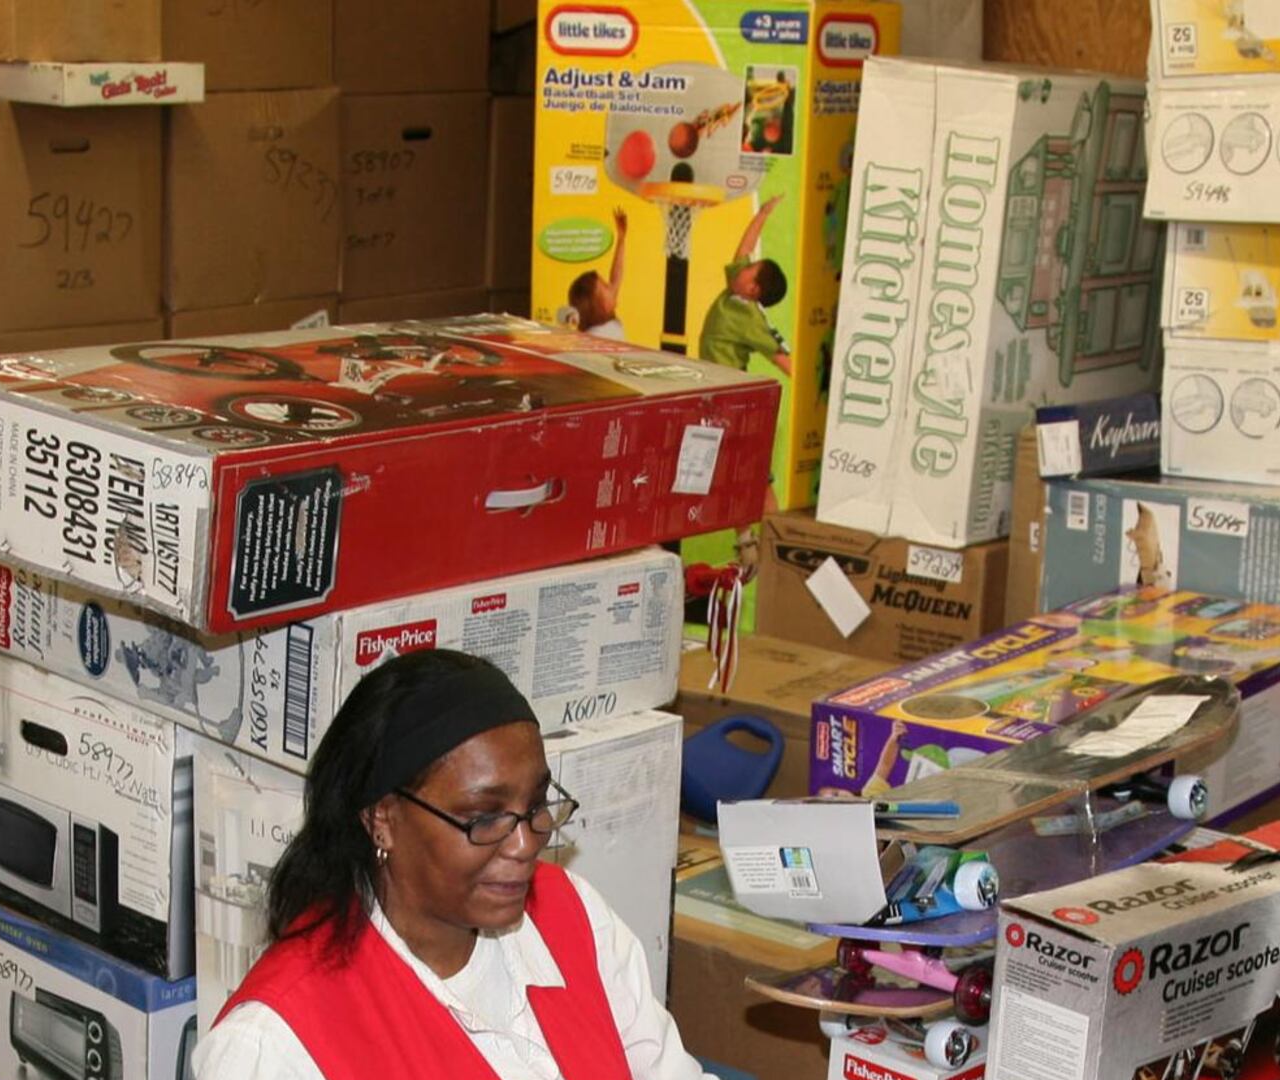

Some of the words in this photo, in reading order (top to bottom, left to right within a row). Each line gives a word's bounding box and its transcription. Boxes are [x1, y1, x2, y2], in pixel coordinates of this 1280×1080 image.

[557, 20, 589, 39] little
[591, 22, 627, 40] tikes
[543, 88, 615, 102] Basketball
[618, 90, 641, 102] Set
[544, 68, 614, 88] Adjust
[618, 71, 634, 88] &
[638, 71, 687, 91] Jam
[543, 100, 586, 113] Juego
[589, 100, 606, 112] de
[609, 101, 685, 116] baloncesto
[838, 161, 923, 430] Kitchen
[912, 131, 1001, 480] Homesyle
[1090, 412, 1160, 460] Keyboar
[24, 428, 60, 519] 35112
[62, 440, 102, 565] 6308431
[870, 583, 973, 621] McQUEEN
[358, 628, 436, 656] Fisher-Price
[73, 704, 164, 746] professional
[562, 691, 618, 724] K6070
[829, 714, 845, 778] SMART
[841, 716, 858, 780] CYCLE
[1086, 877, 1199, 915] Razor
[1025, 931, 1097, 970] Razor
[1037, 954, 1067, 975] Cruiser
[1067, 966, 1100, 985] scooter
[1148, 921, 1251, 981] Razor
[160, 982, 192, 1000] large
[1161, 967, 1224, 1004] Cruiser
